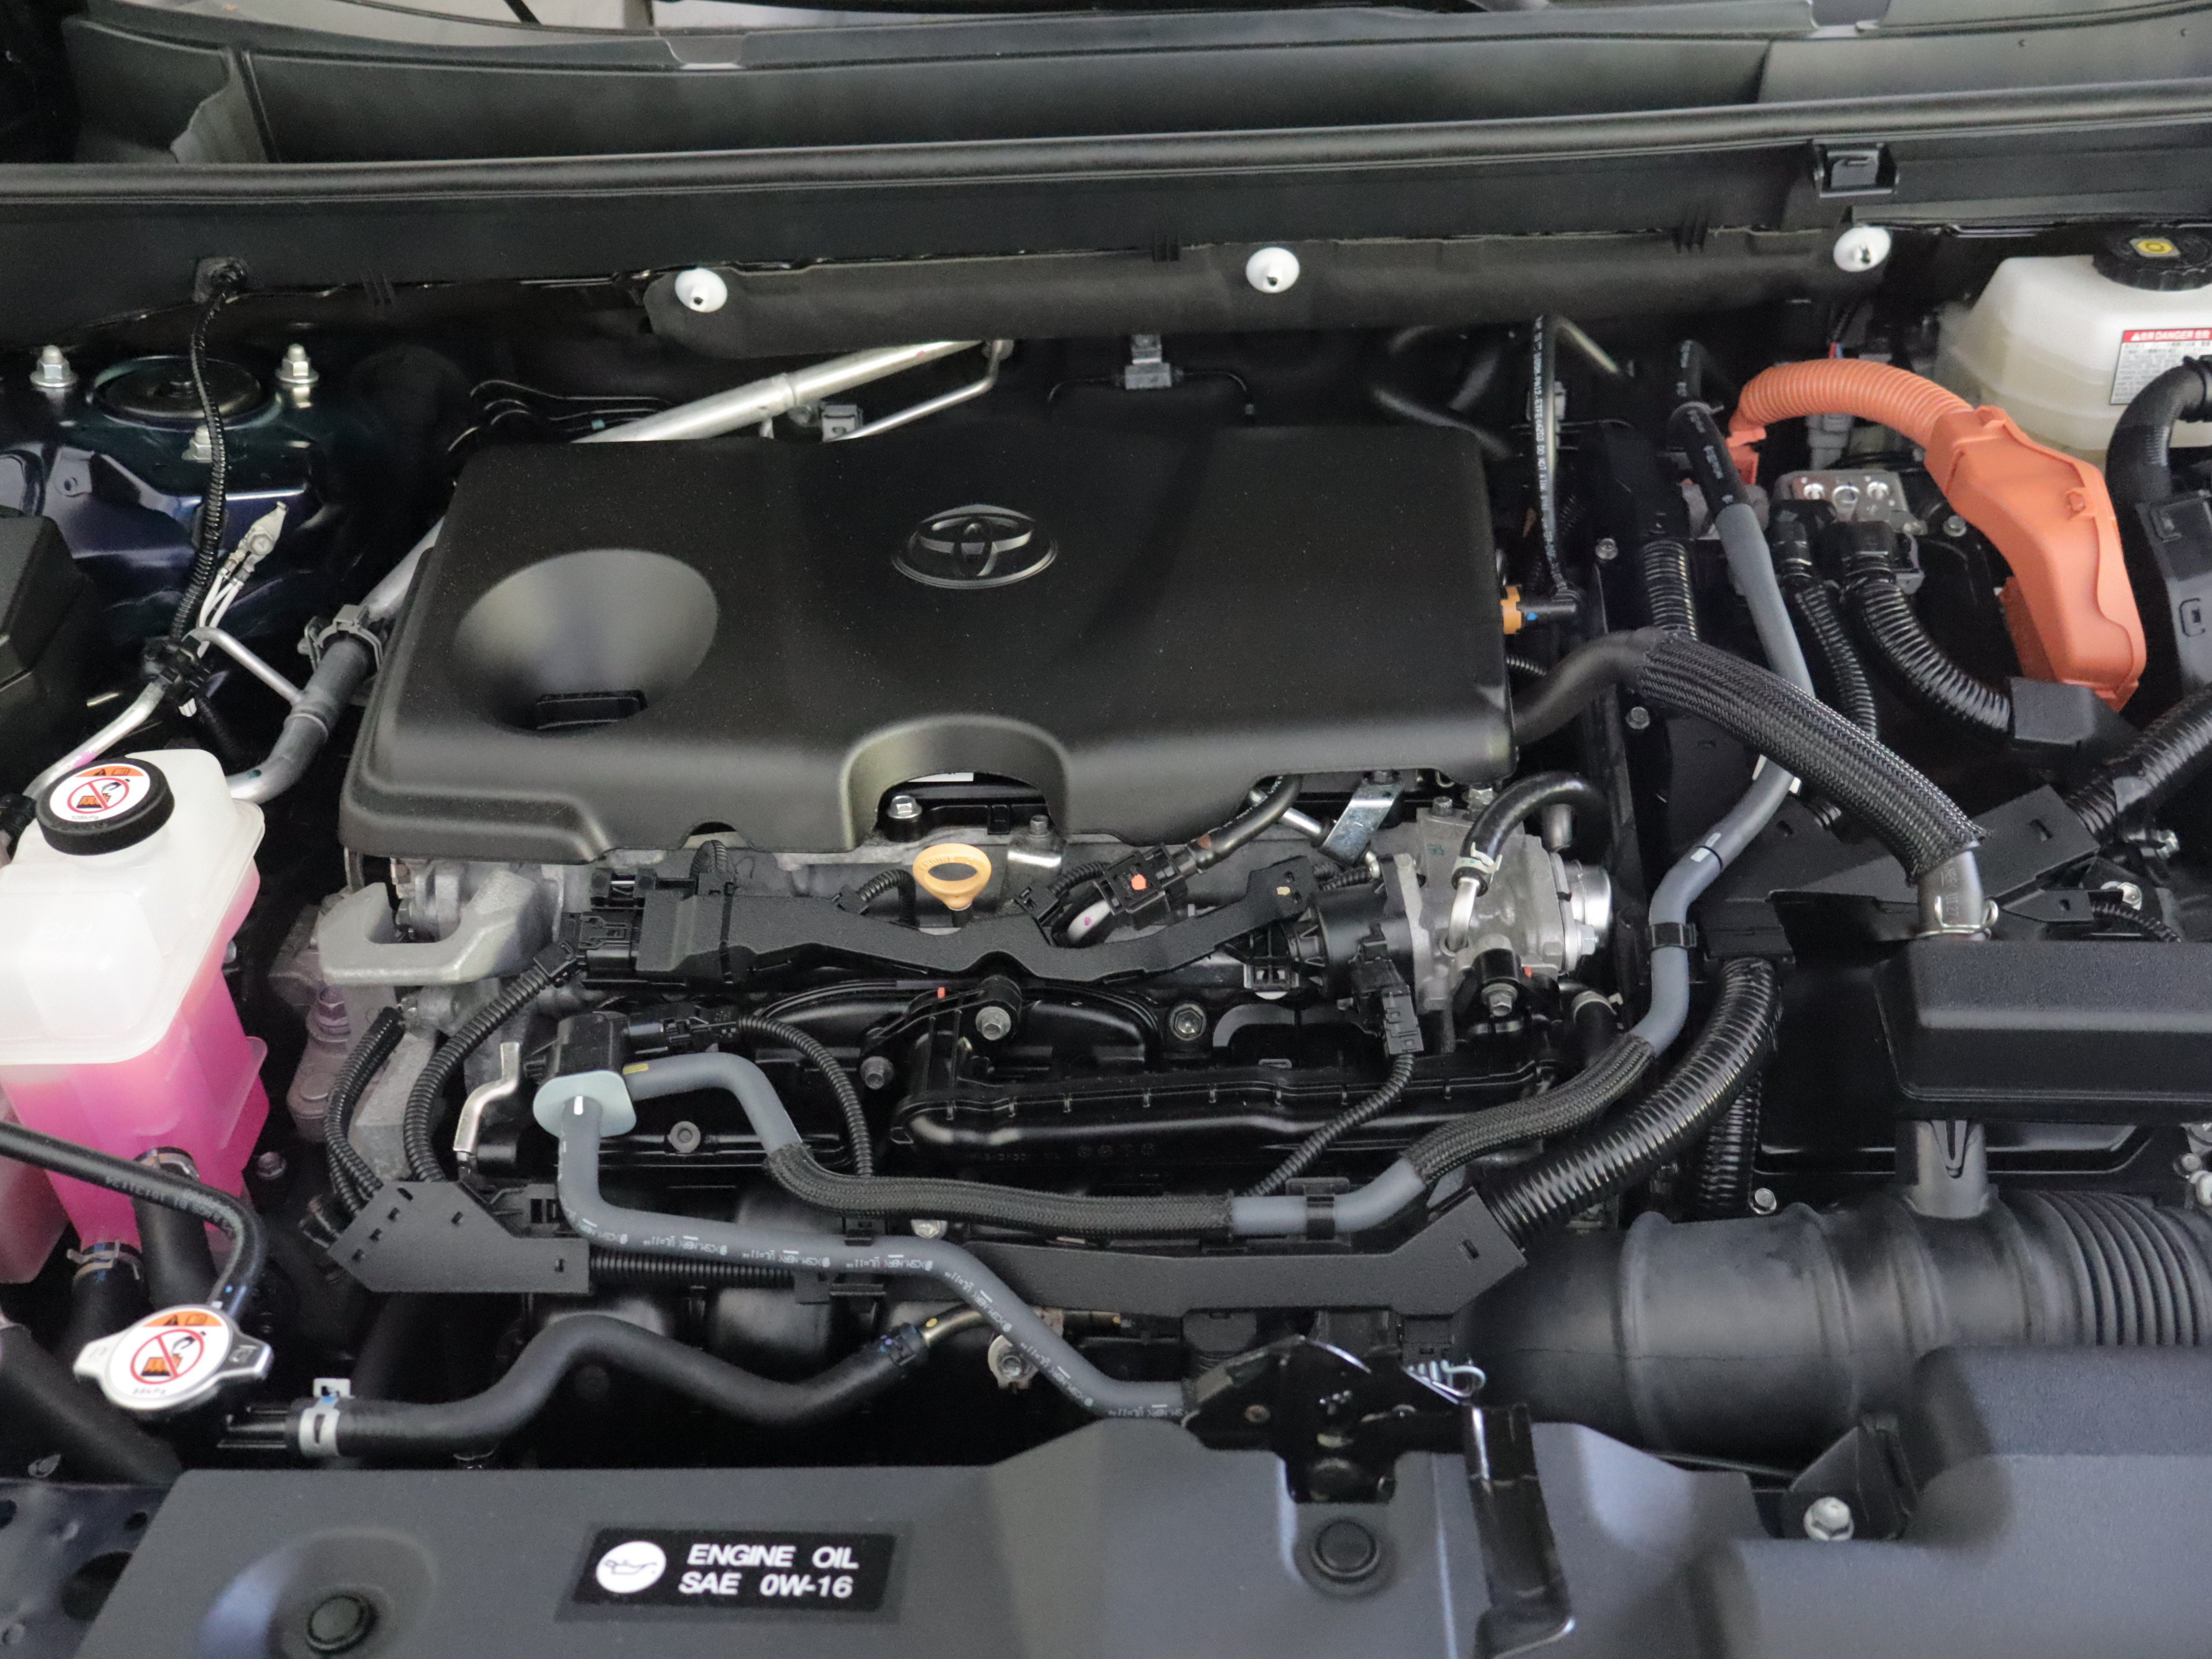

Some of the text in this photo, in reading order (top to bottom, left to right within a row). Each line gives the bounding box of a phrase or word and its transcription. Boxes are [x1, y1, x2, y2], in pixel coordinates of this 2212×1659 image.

[686, 1543, 859, 1570] ENGINE OIL
[678, 1571, 854, 1599] SAE 0W-16
